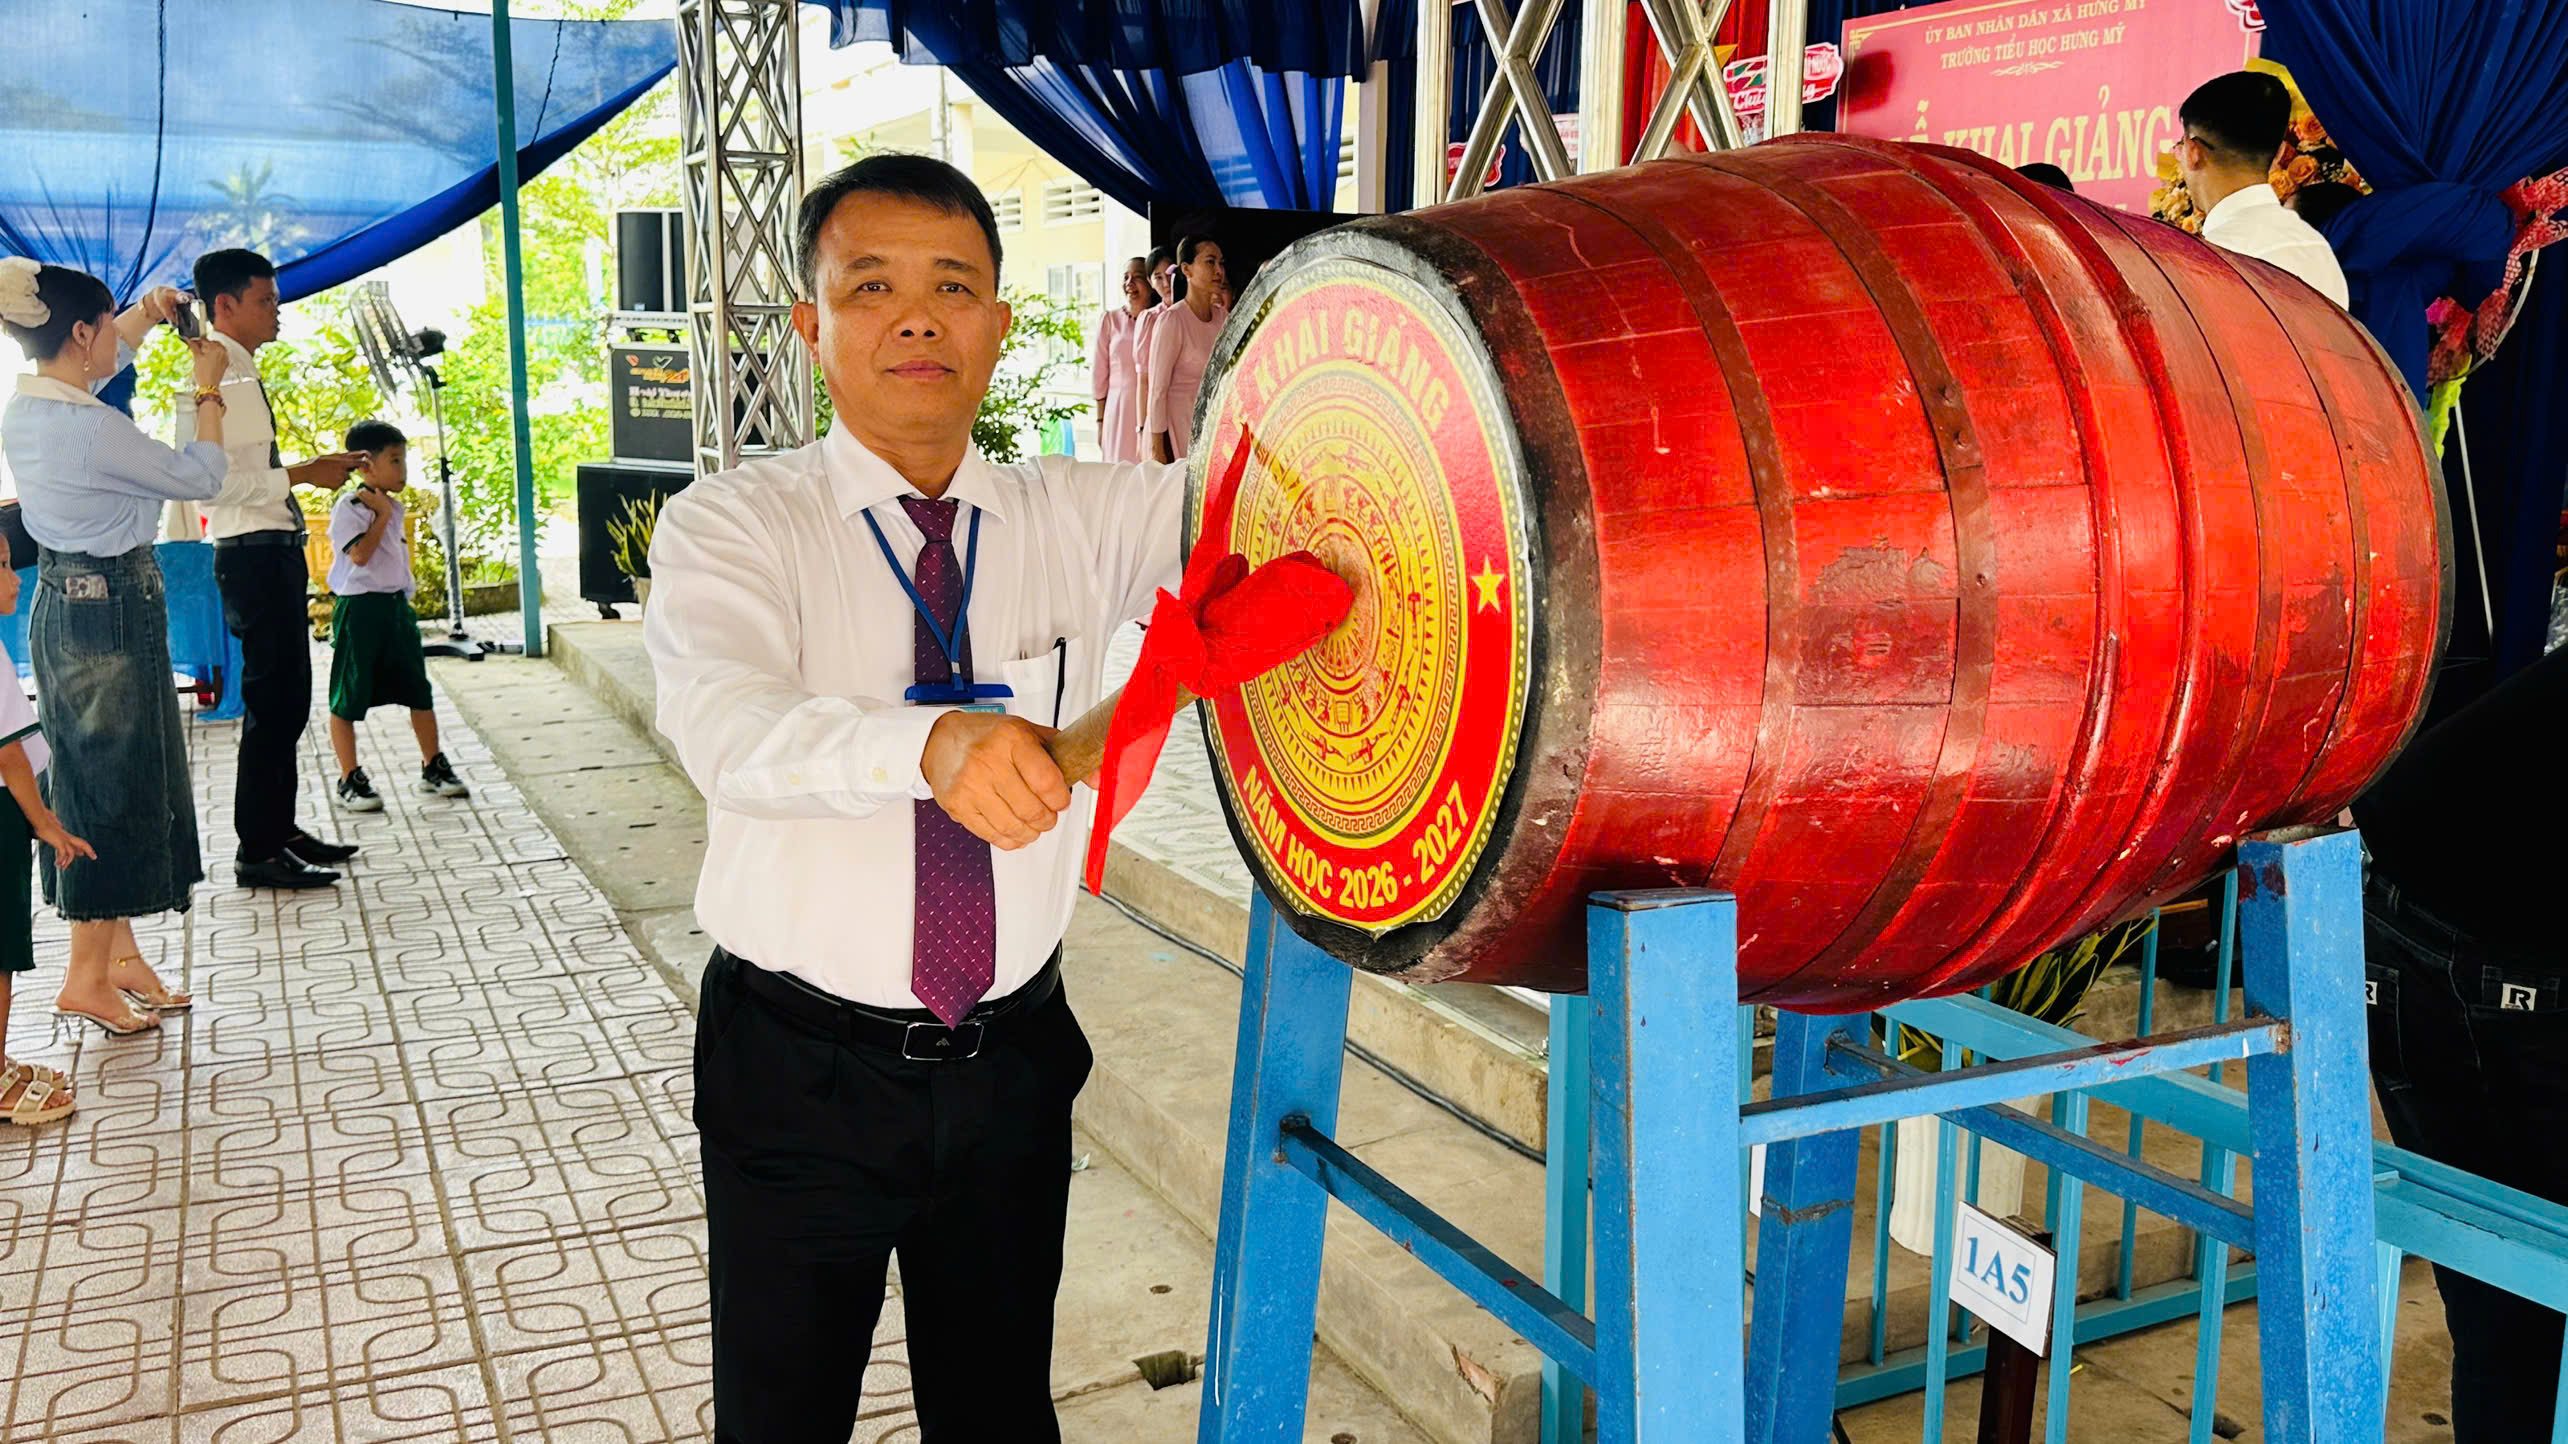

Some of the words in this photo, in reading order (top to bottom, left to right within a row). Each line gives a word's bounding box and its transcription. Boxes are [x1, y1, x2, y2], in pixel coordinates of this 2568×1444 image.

[1940, 45, 1990, 70] TRƯỜNG
[1995, 33, 2025, 61] TIỂU
[2028, 36, 2056, 58] HỌC
[1945, 23, 1973, 41] BAN
[1975, 15, 2015, 36] NHÂN
[2018, 9, 2048, 28] DÂN
[1944, 121, 2034, 170] HAI
[2045, 85, 2174, 182] GIẢNG
[1253, 311, 1329, 403] KHAI
[1344, 308, 1449, 432] GIẢNG
[1243, 765, 1287, 854] NĂM
[1286, 834, 1333, 899] HỌC
[1339, 860, 1398, 910] 2026
[1403, 874, 1413, 888] -
[1412, 781, 1469, 885] 2027
[2509, 987, 2532, 1011] R
[1964, 1236, 2031, 1305] 1A5
